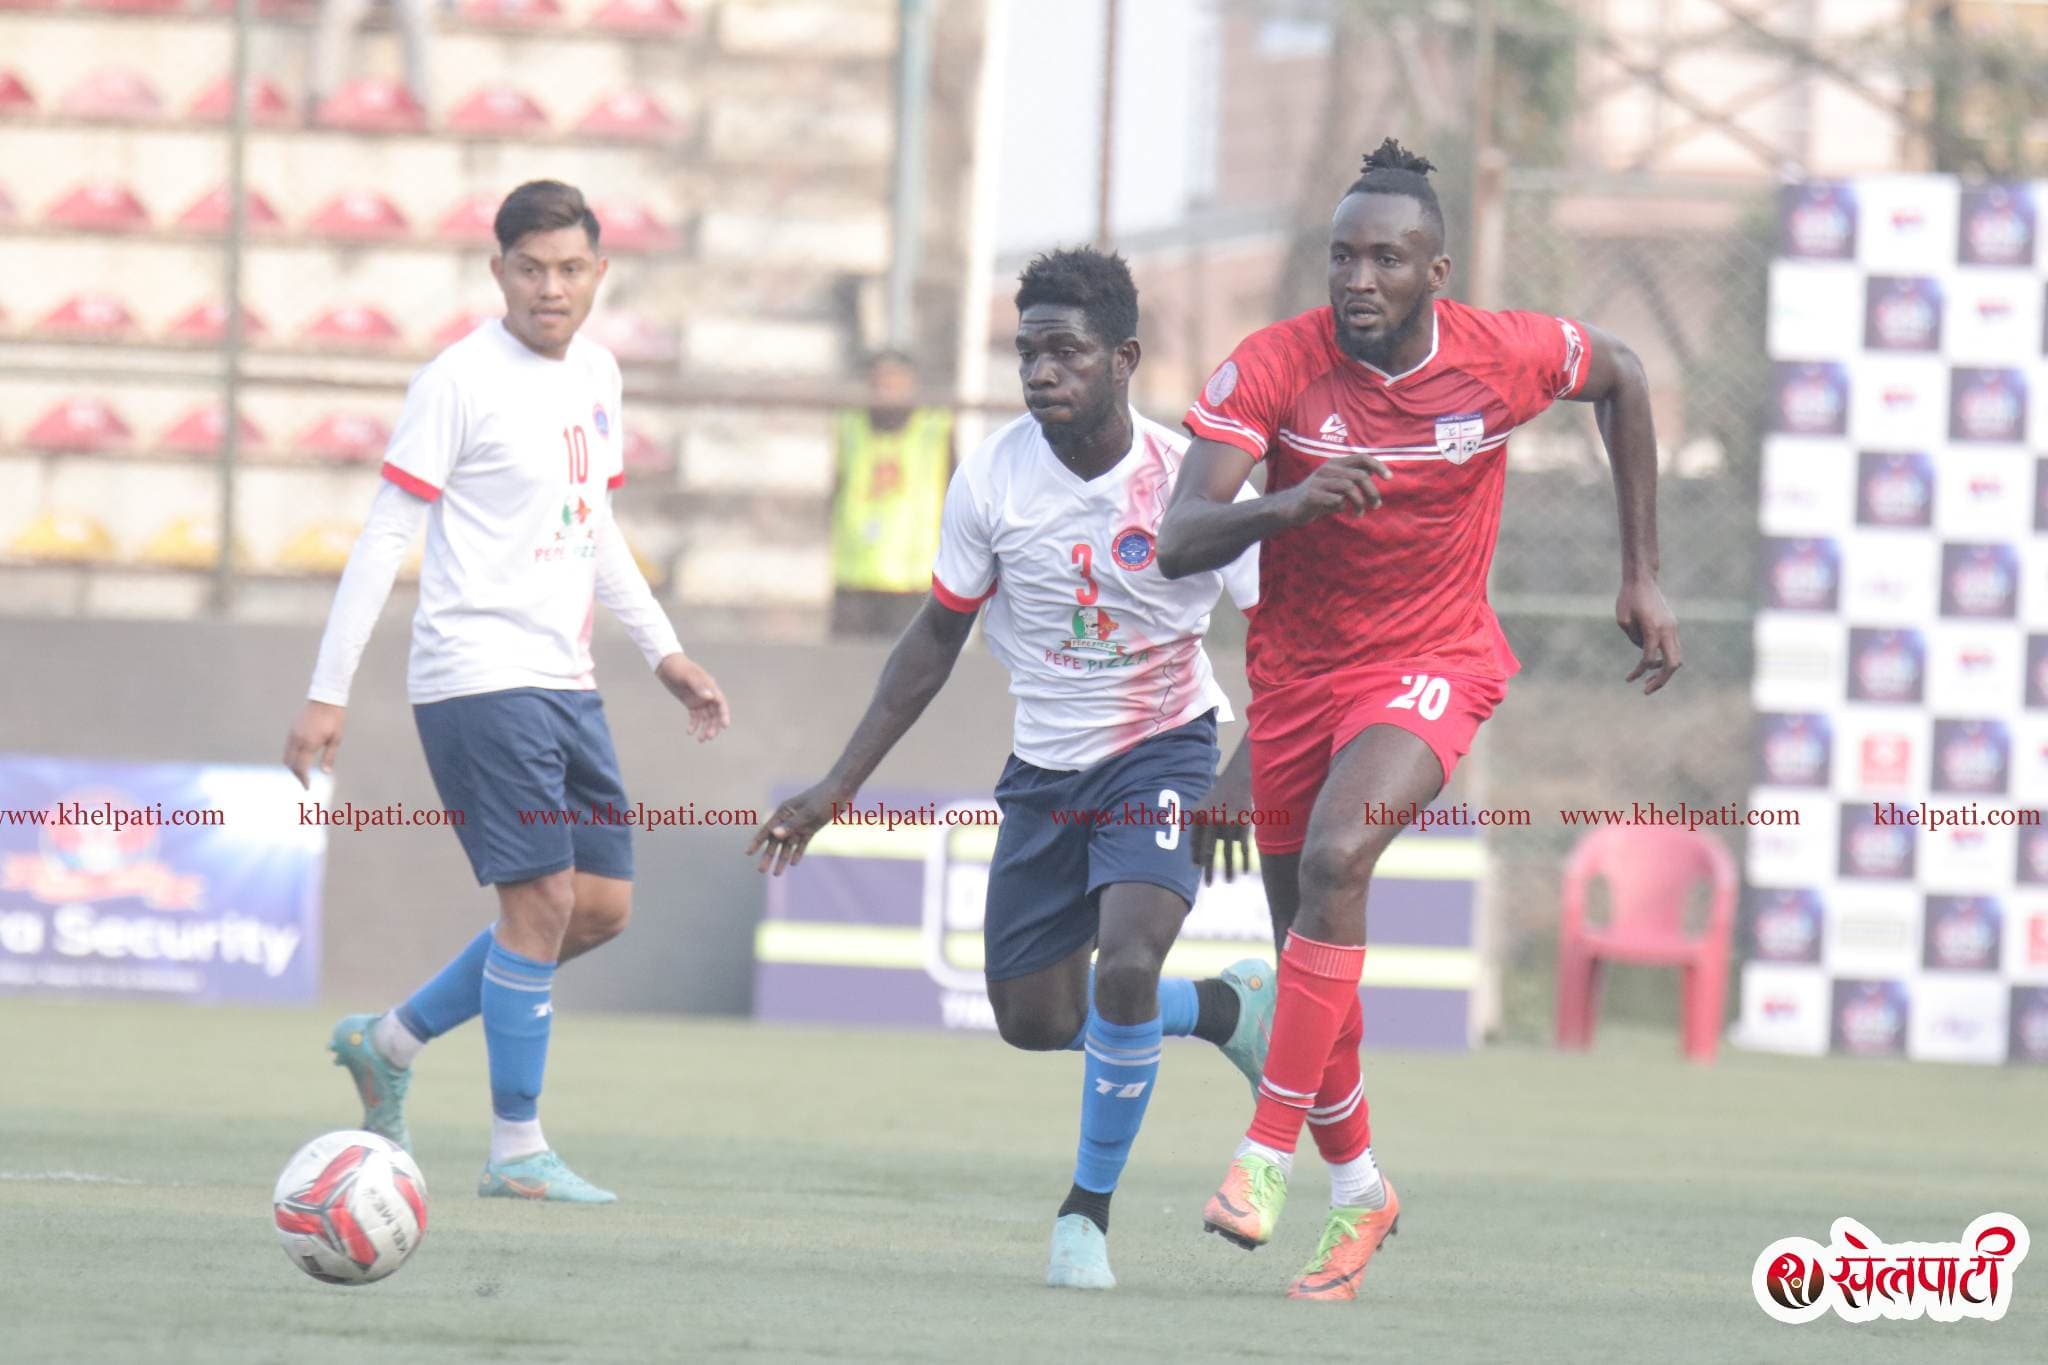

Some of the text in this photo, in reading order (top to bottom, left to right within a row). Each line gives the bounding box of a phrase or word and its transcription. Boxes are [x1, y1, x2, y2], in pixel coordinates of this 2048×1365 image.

[563, 425, 588, 485] 10
[1072, 543, 1098, 606] 3
[1045, 648, 1149, 671] PEPE PIZZA
[1385, 674, 1451, 720] 20
[1155, 789, 1180, 850] 3
[54, 903, 300, 978] Security
